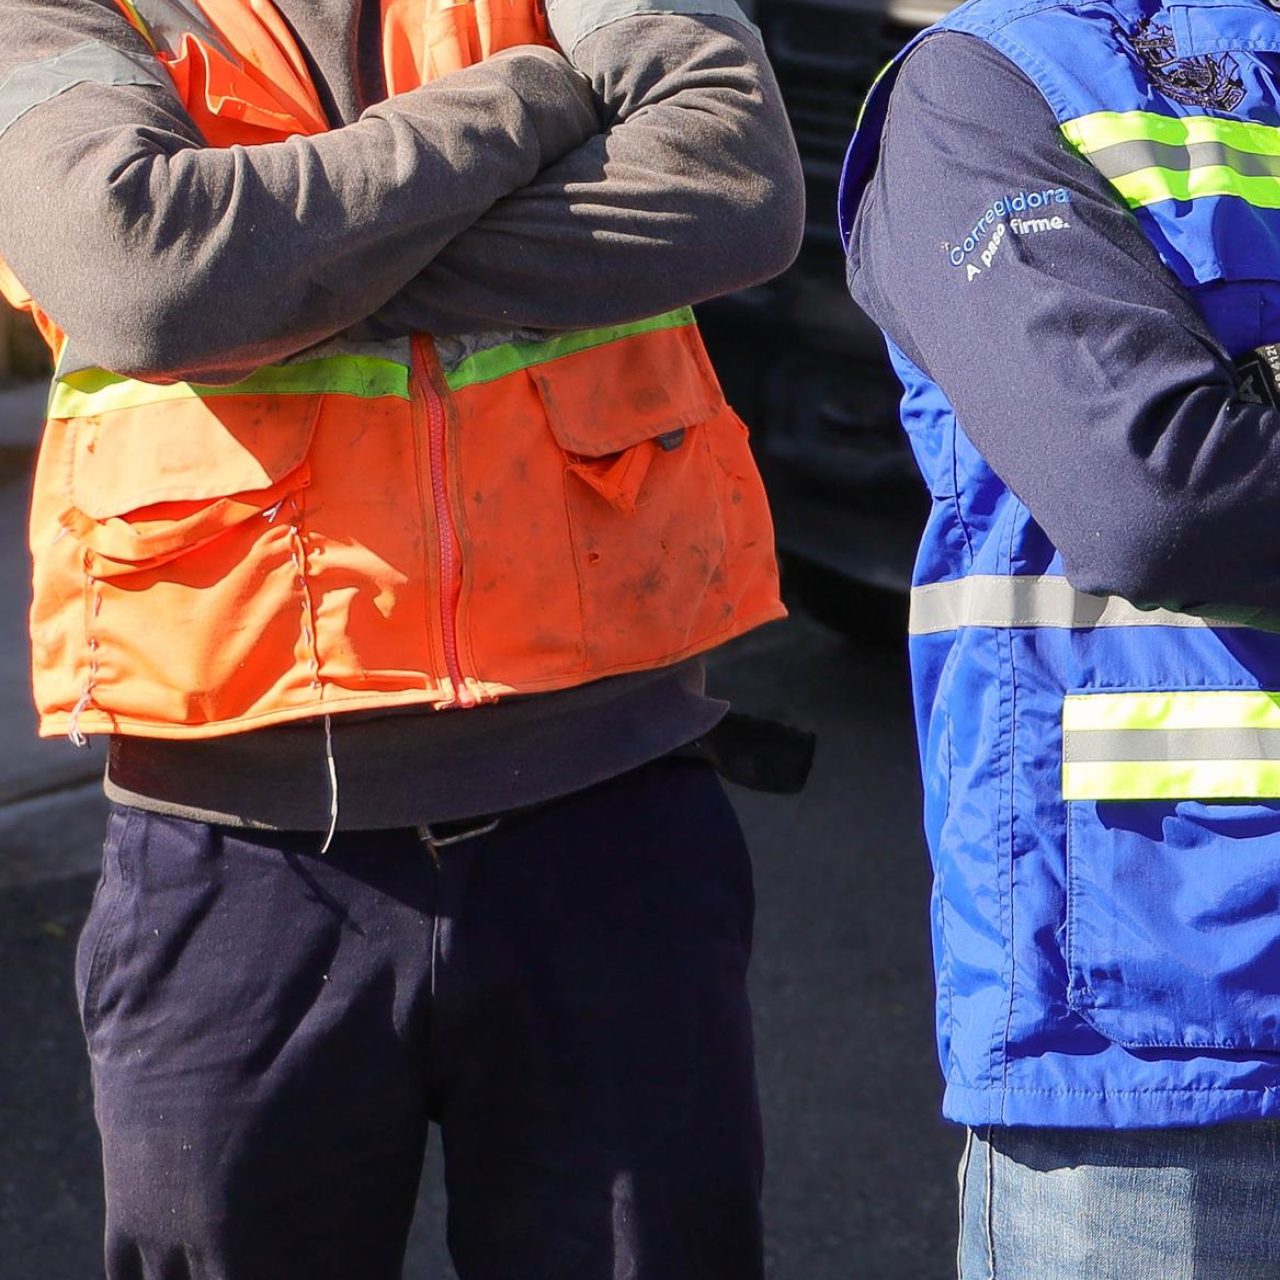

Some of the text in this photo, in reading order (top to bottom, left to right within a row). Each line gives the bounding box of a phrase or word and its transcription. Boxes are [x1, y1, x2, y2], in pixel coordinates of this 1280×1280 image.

[950, 187, 1072, 266] Corregidora
[965, 216, 1071, 282] A paso firme.
